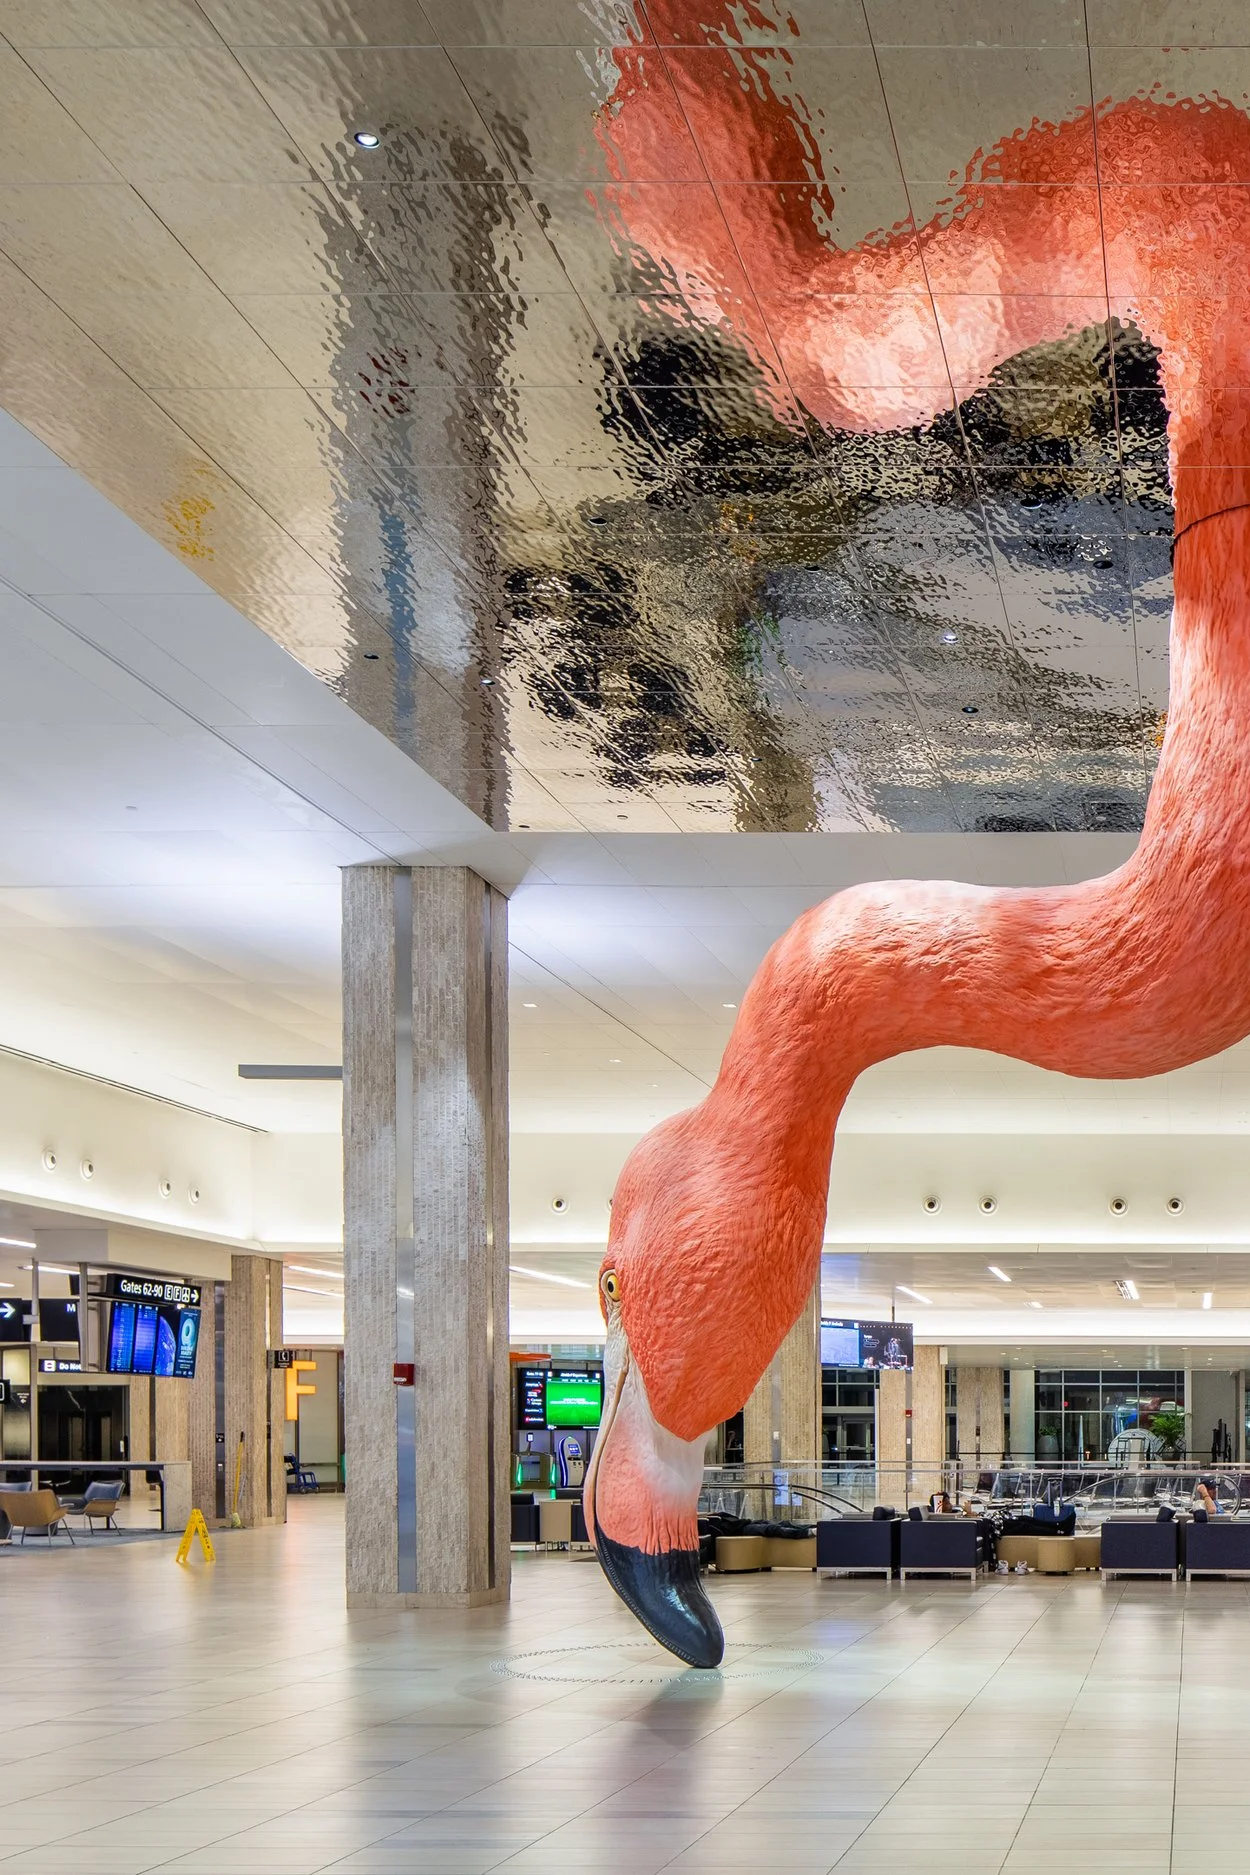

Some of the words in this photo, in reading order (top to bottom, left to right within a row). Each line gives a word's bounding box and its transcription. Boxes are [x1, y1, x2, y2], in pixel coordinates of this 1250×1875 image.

[120, 1279, 142, 1295] Gates
[142, 1282, 163, 1298] 62-90
[66, 1303, 76, 1312] M
[285, 1361, 317, 1421] F
